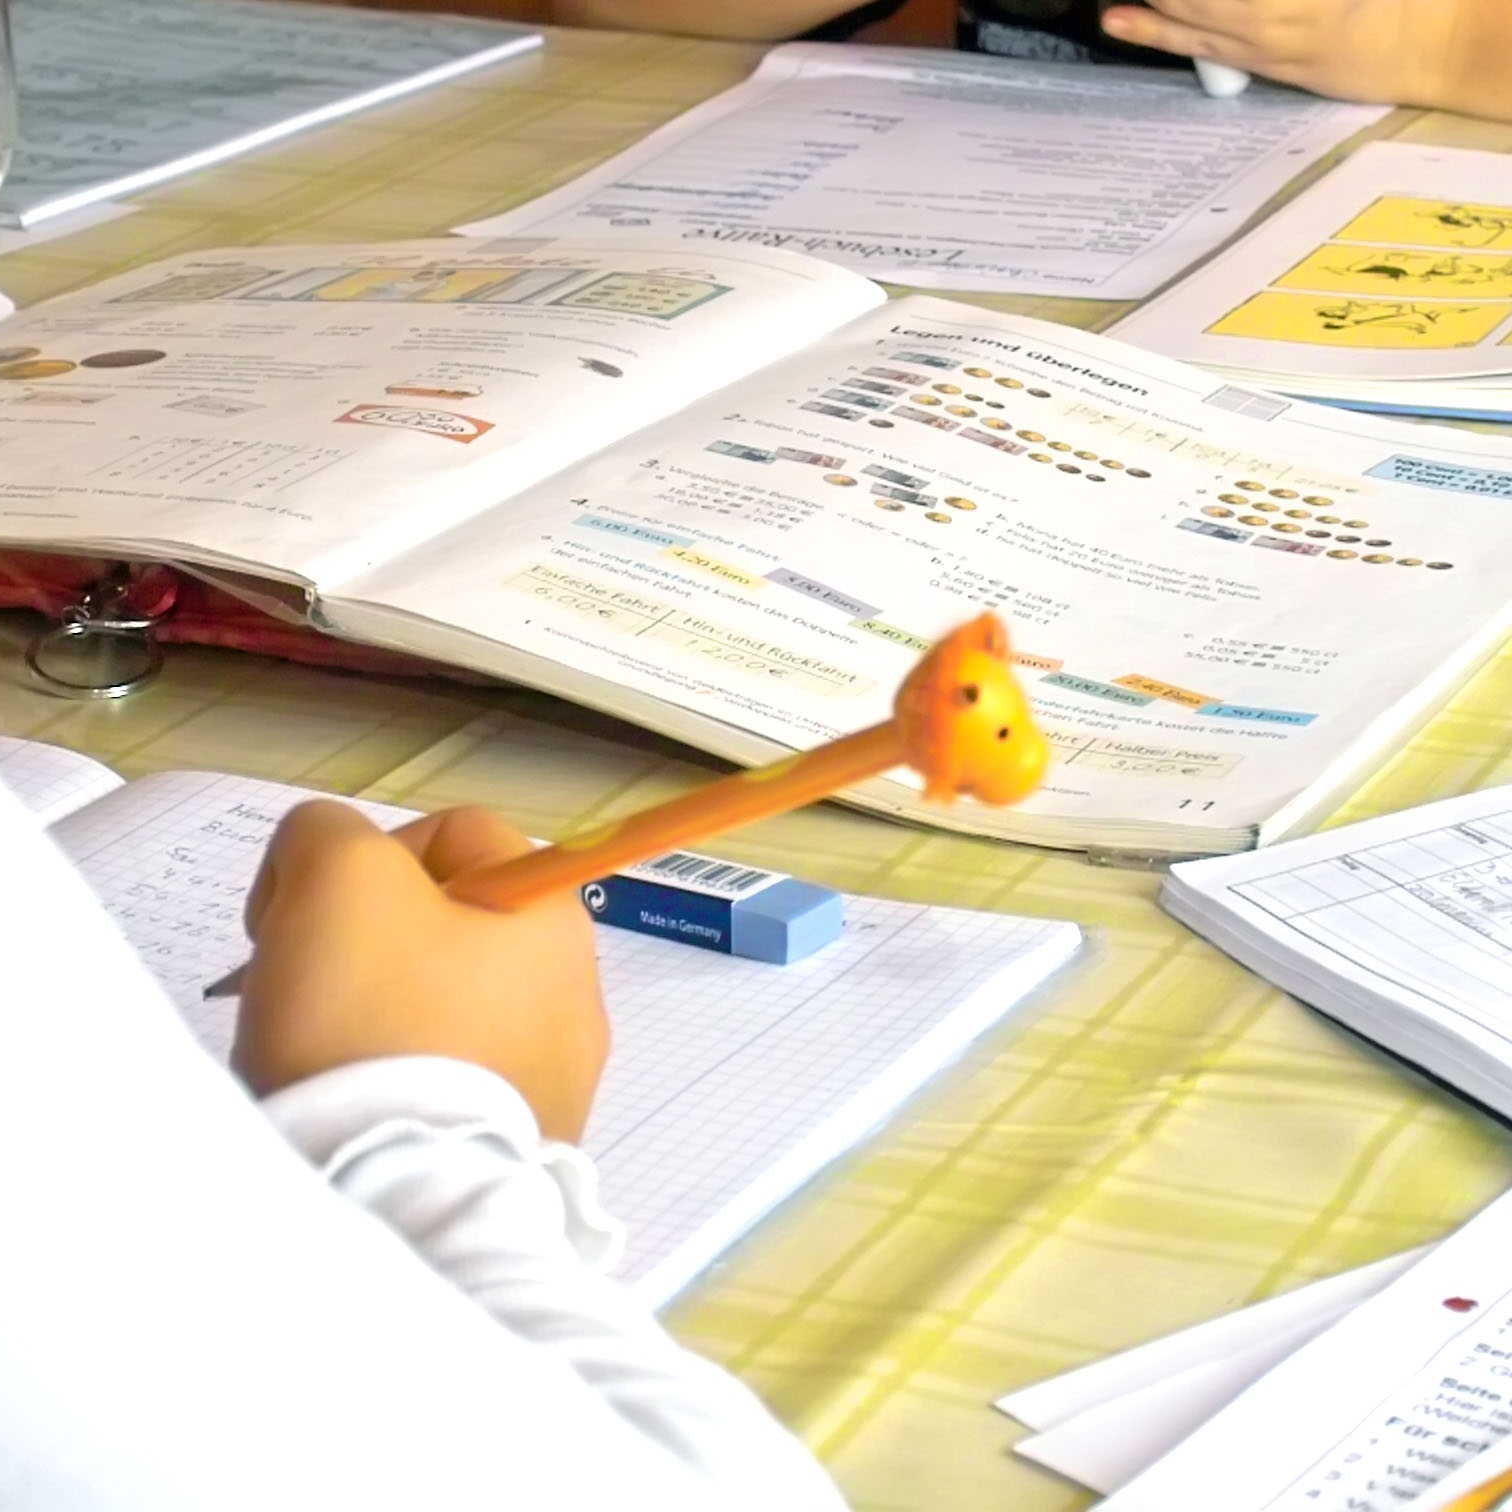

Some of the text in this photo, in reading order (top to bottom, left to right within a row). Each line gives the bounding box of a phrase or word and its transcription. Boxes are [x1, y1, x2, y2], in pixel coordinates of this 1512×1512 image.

[682, 227, 967, 265] Lesebuch-Rallye
[889, 324, 1149, 399] Legen und überlegen
[1406, 475, 1447, 487] Cent
[1416, 469, 1456, 481] Cent
[1425, 463, 1465, 475] Cent
[665, 519, 736, 550] einfache
[1015, 520, 1060, 543] Mona
[1110, 552, 1145, 569] Euro
[577, 553, 650, 587] einfachen
[598, 549, 633, 567] und
[634, 558, 713, 594] Rückfahrt
[712, 587, 763, 611] kosten
[529, 563, 661, 616] Einfache Fahrt
[726, 629, 766, 653] und
[766, 645, 859, 685] Rückfahrt
[1104, 738, 1222, 764] Halber Preis
[639, 909, 667, 928] Made
[678, 918, 724, 944] Germany
[1434, 1392, 1484, 1413] Hier
[1439, 1376, 1503, 1403] Seite
[1385, 1415, 1438, 1440] Für
